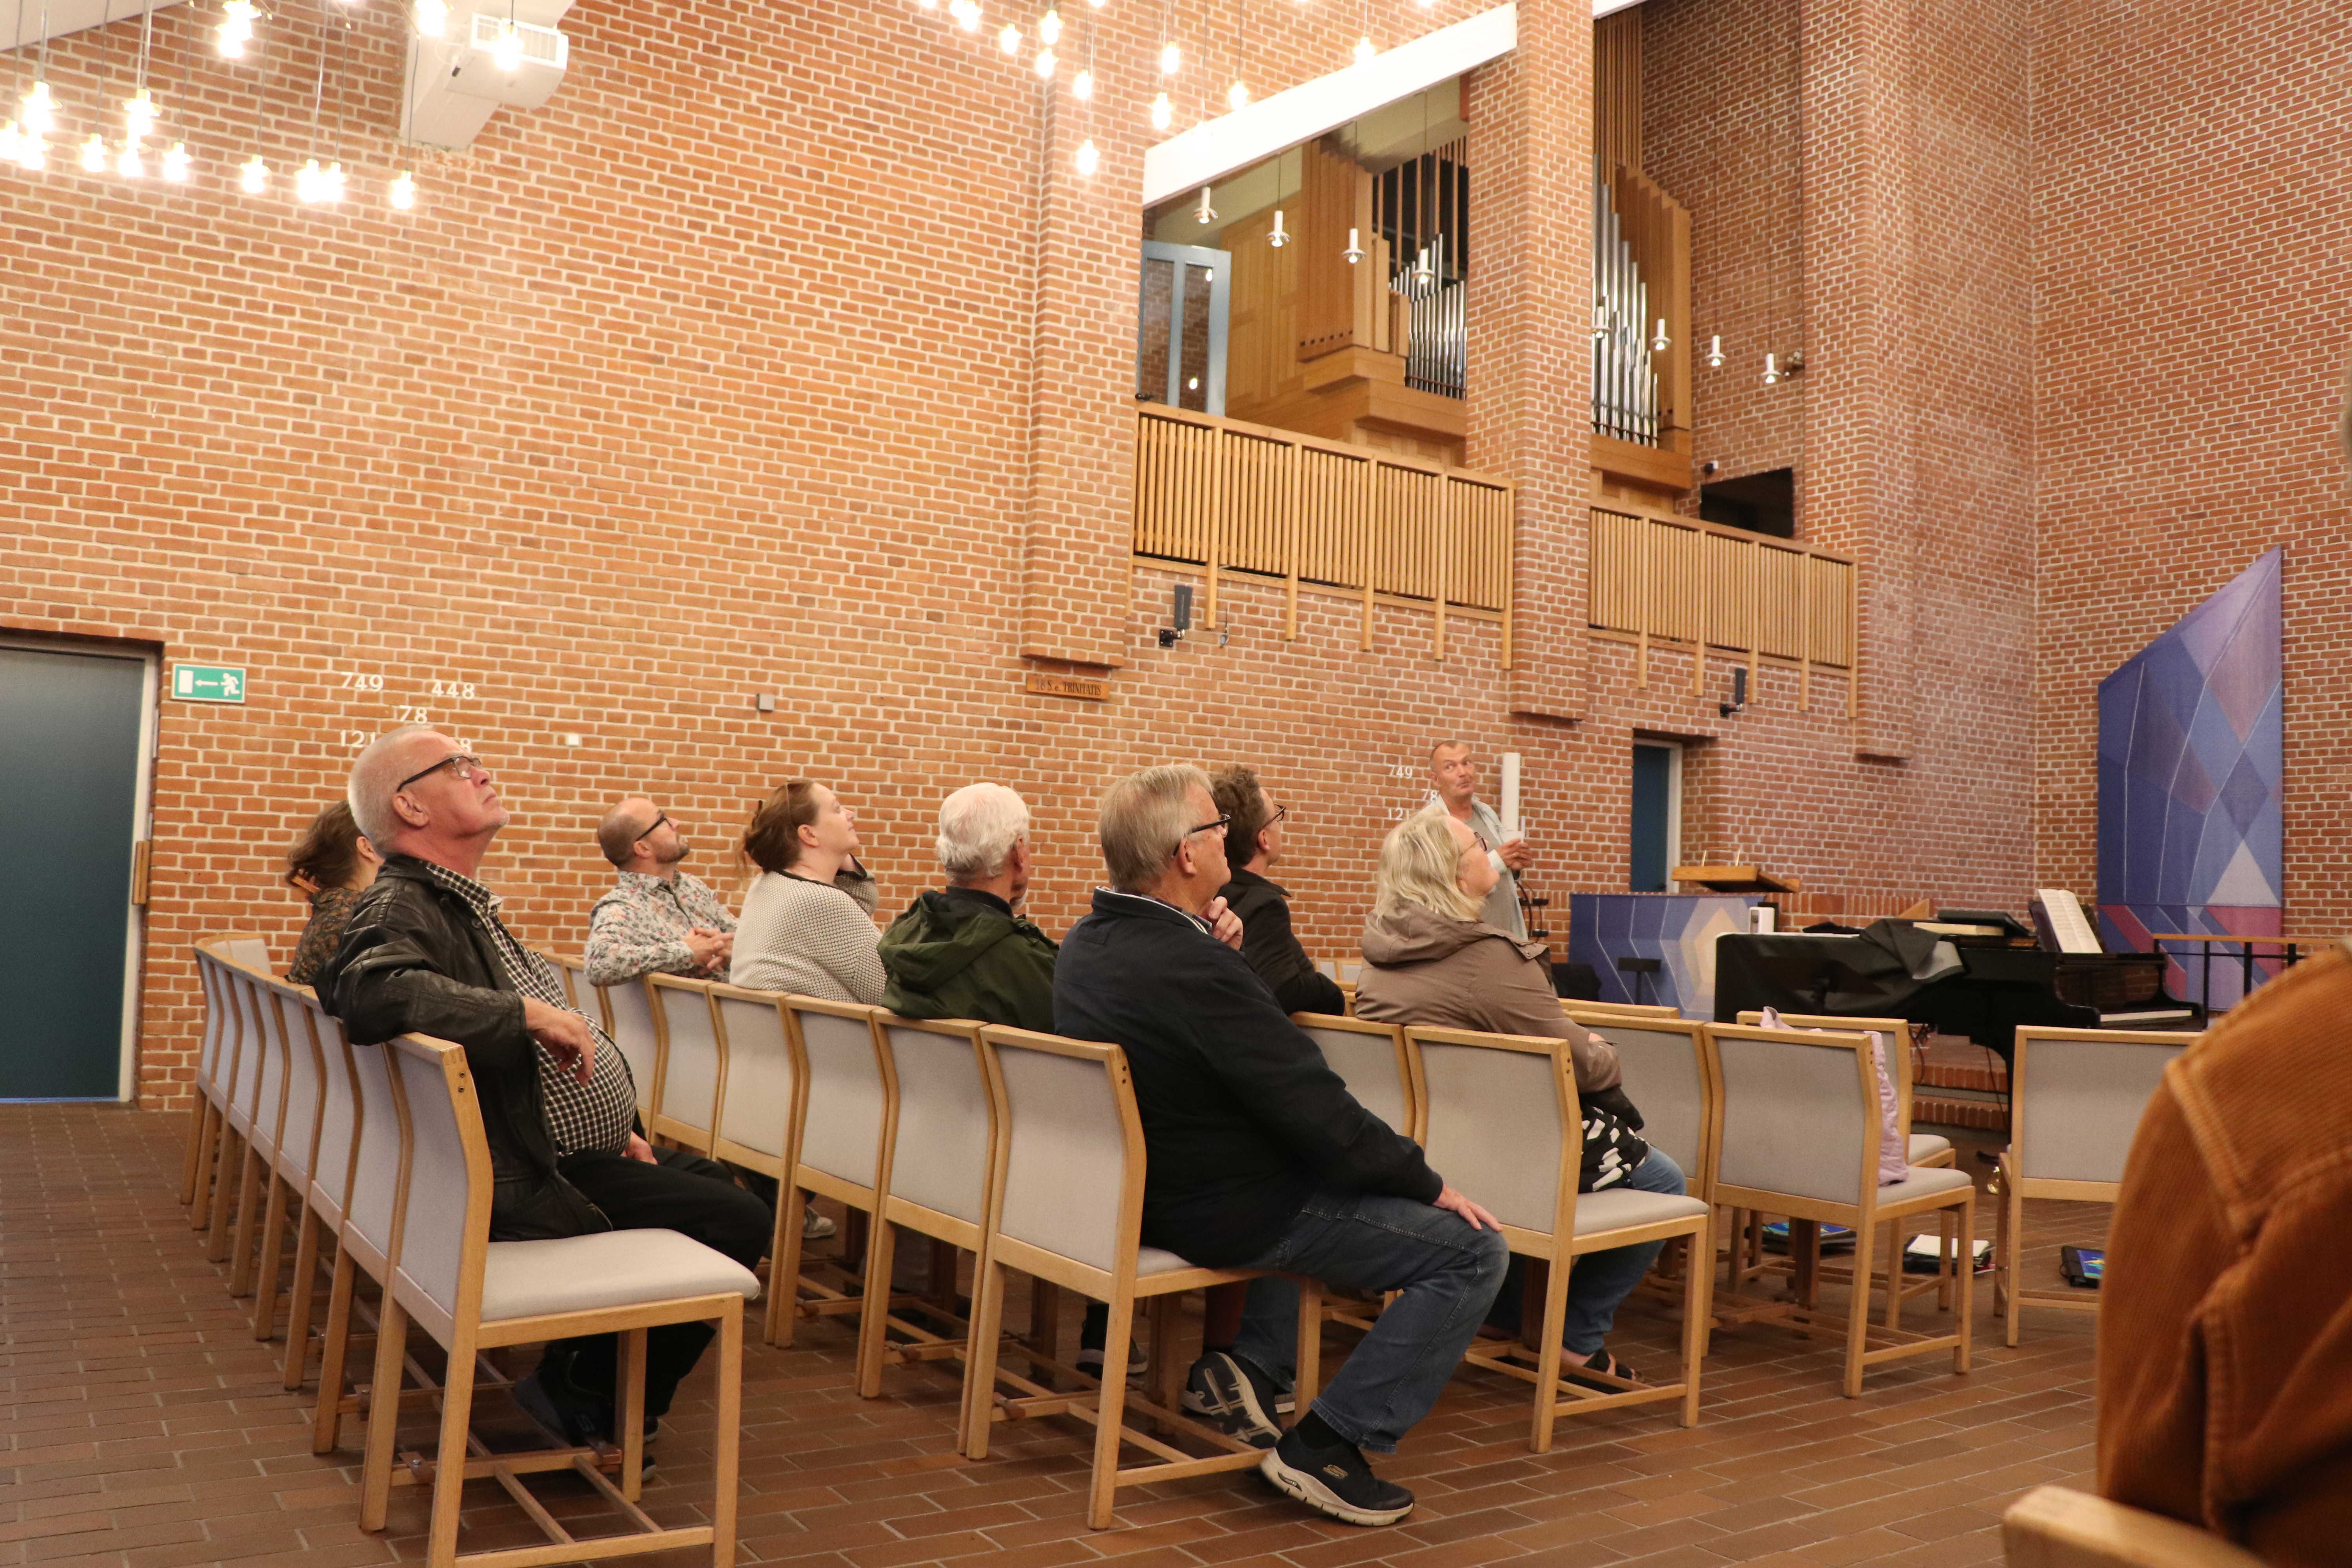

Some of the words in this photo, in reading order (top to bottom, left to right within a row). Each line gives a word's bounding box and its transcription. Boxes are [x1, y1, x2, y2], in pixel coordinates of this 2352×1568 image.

[340, 671, 384, 691] 749
[432, 679, 475, 699] 448
[1063, 681, 1101, 696] TRINITATIS
[399, 705, 428, 724] 78
[341, 730, 376, 748] 121
[1389, 764, 1413, 779] 749
[1421, 788, 1438, 802] 78
[1388, 808, 1409, 820] 121
